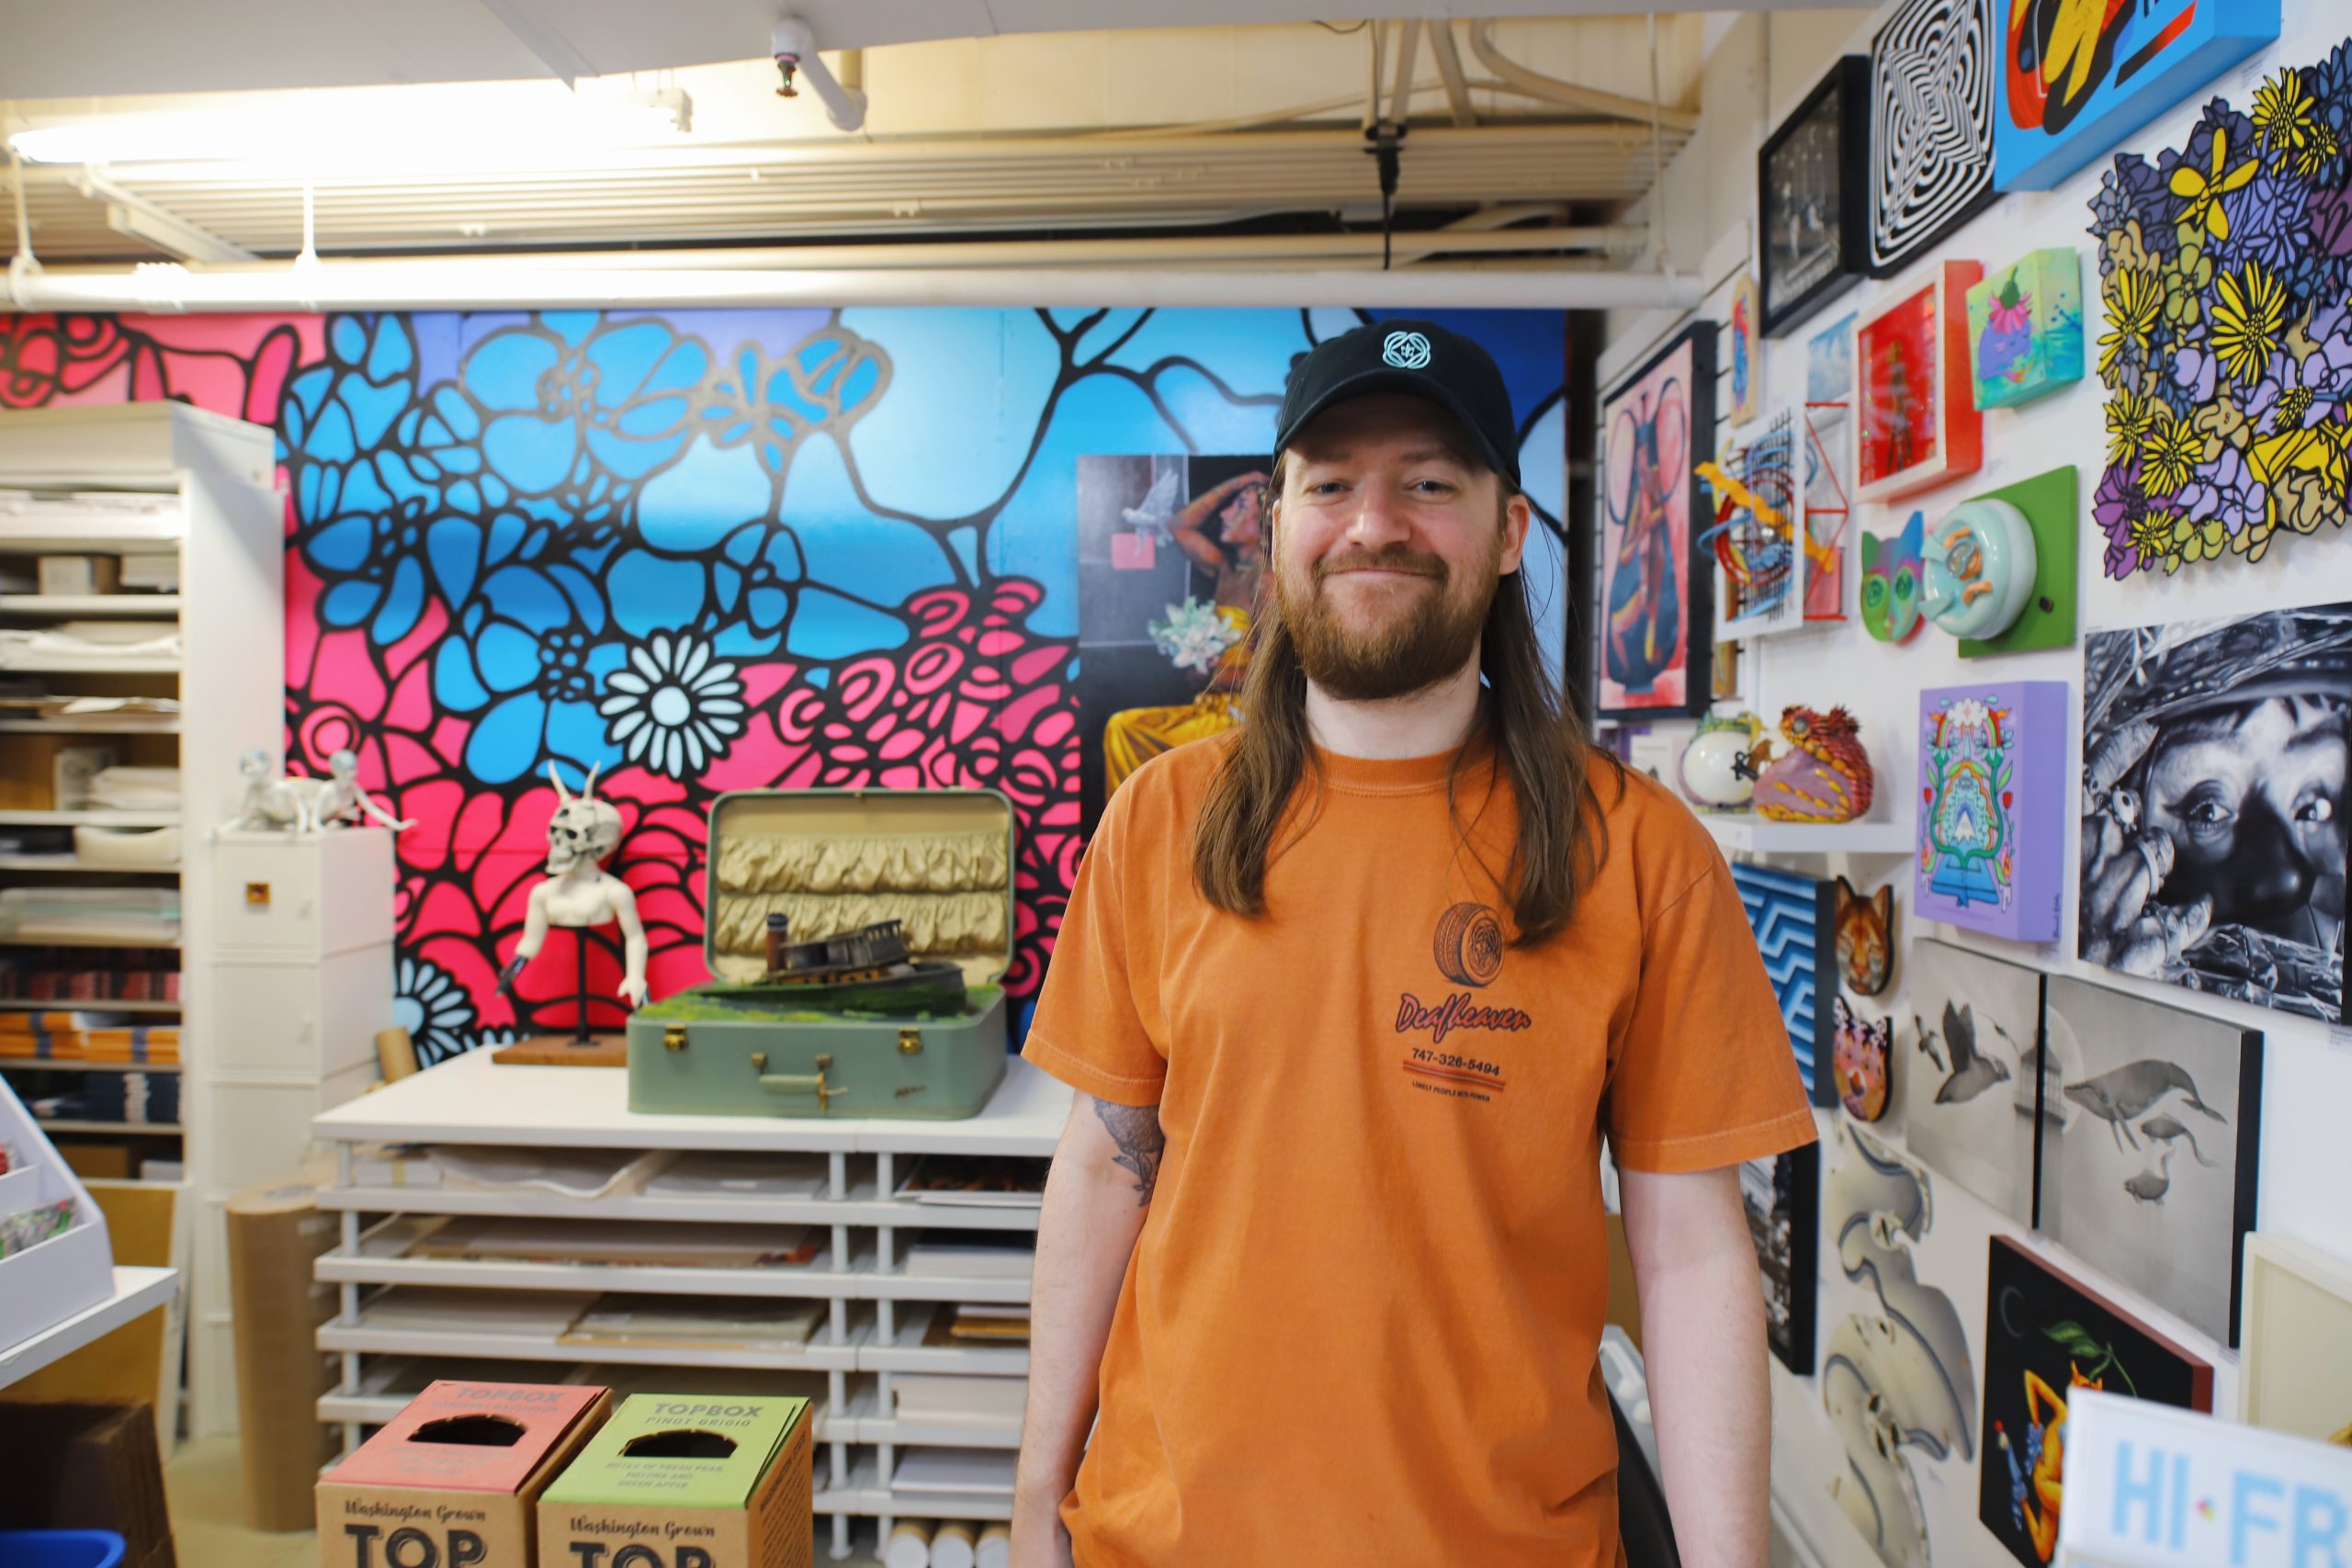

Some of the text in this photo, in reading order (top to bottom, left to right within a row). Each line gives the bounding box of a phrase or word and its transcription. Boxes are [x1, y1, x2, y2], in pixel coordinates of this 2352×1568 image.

[1396, 992, 1532, 1043] Deafheaven
[1412, 1047, 1500, 1077] 747-326-5494
[1412, 1080, 1432, 1091] LONELY
[1433, 1087, 1456, 1097] PEOPLE
[456, 1387, 564, 1404] TOPBOX
[645, 1417, 752, 1427] PINOT GRIGIO
[654, 1403, 764, 1417] TOPBOX
[345, 1497, 487, 1524] Washington Grown
[570, 1515, 716, 1540] Washington Grown
[345, 1523, 488, 1568] TOP
[570, 1541, 717, 1568] TOP
